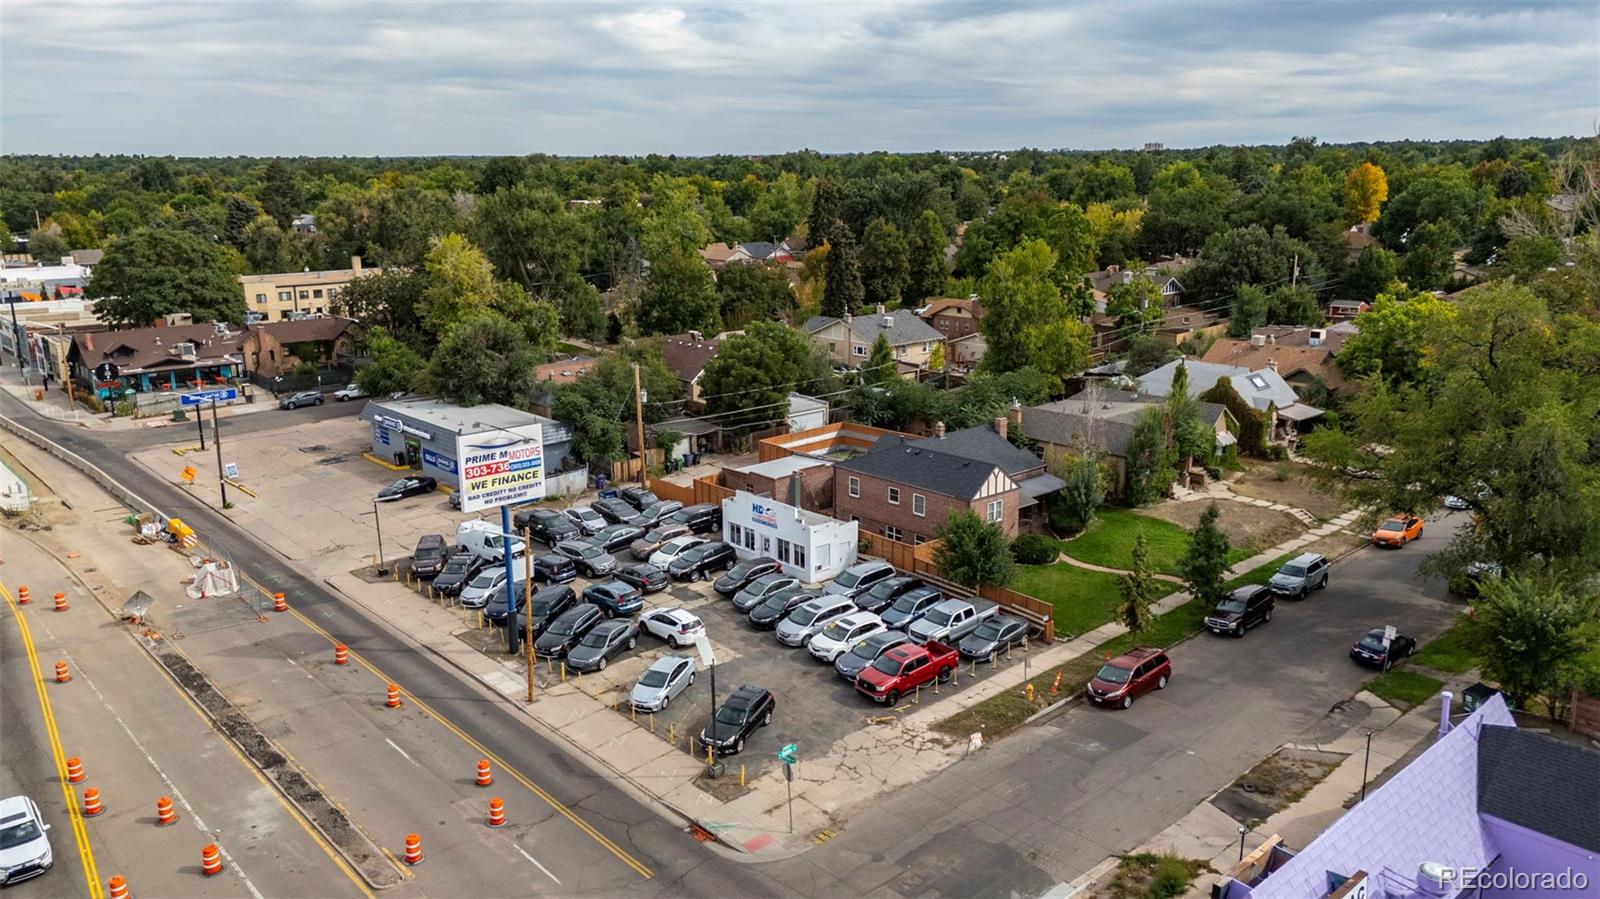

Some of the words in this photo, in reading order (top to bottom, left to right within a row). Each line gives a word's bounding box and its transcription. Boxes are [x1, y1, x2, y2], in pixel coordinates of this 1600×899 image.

[465, 453, 496, 465] PRIME
[508, 446, 541, 460] MOTORS
[466, 461, 510, 478] 303-736
[471, 480, 488, 491] WE
[491, 470, 539, 487] FINANCE
[468, 494, 480, 502] BAD
[482, 489, 507, 498] CREDIT?
[518, 482, 541, 491] CREDIT?
[752, 503, 764, 514] HD
